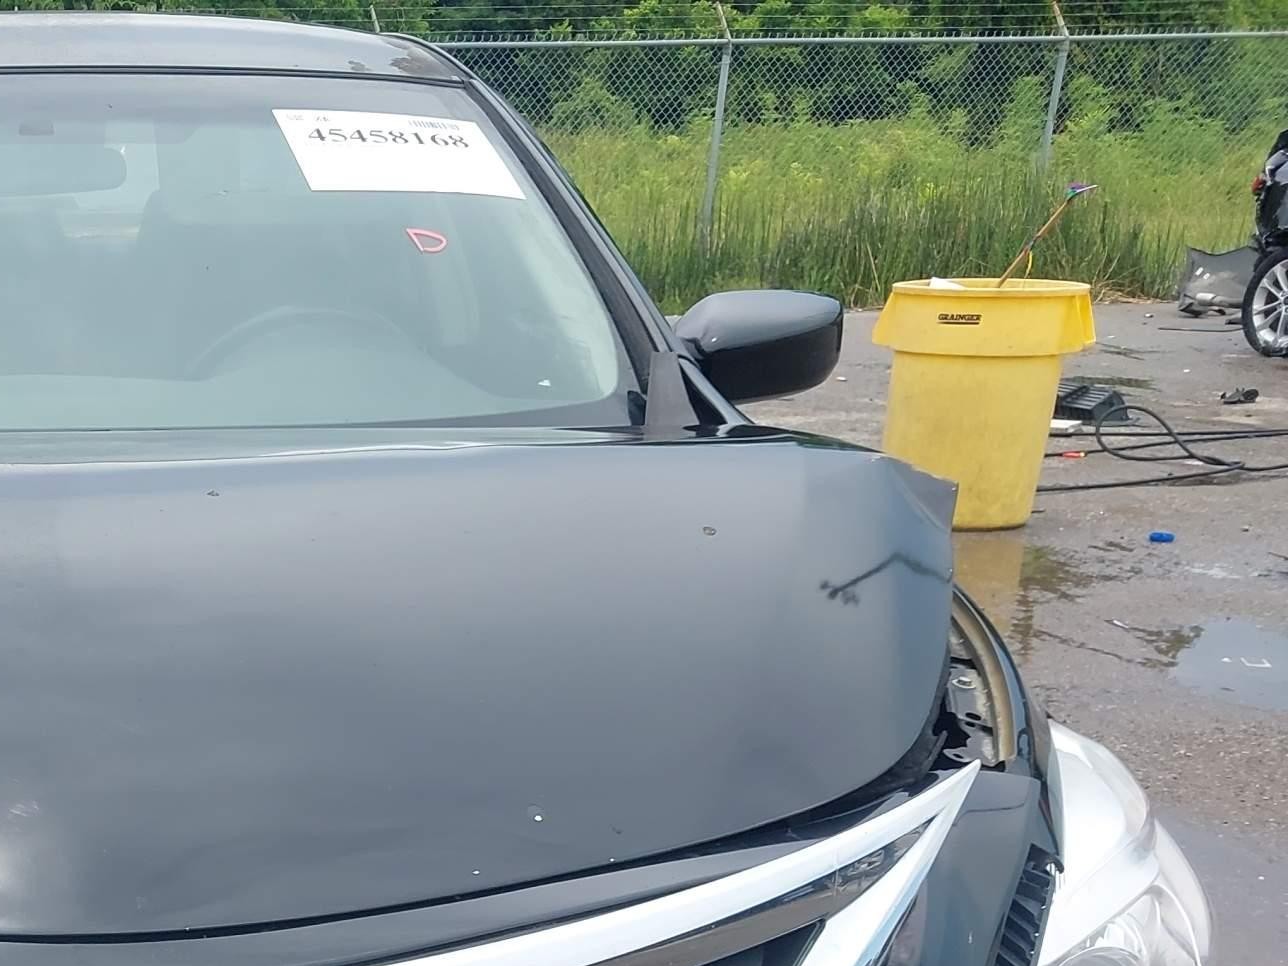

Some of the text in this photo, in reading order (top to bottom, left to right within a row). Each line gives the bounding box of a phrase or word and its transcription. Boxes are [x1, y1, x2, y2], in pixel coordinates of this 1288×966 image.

[308, 127, 470, 149] 45458168
[406, 227, 448, 253] D
[937, 313, 982, 322] GRAINGER
